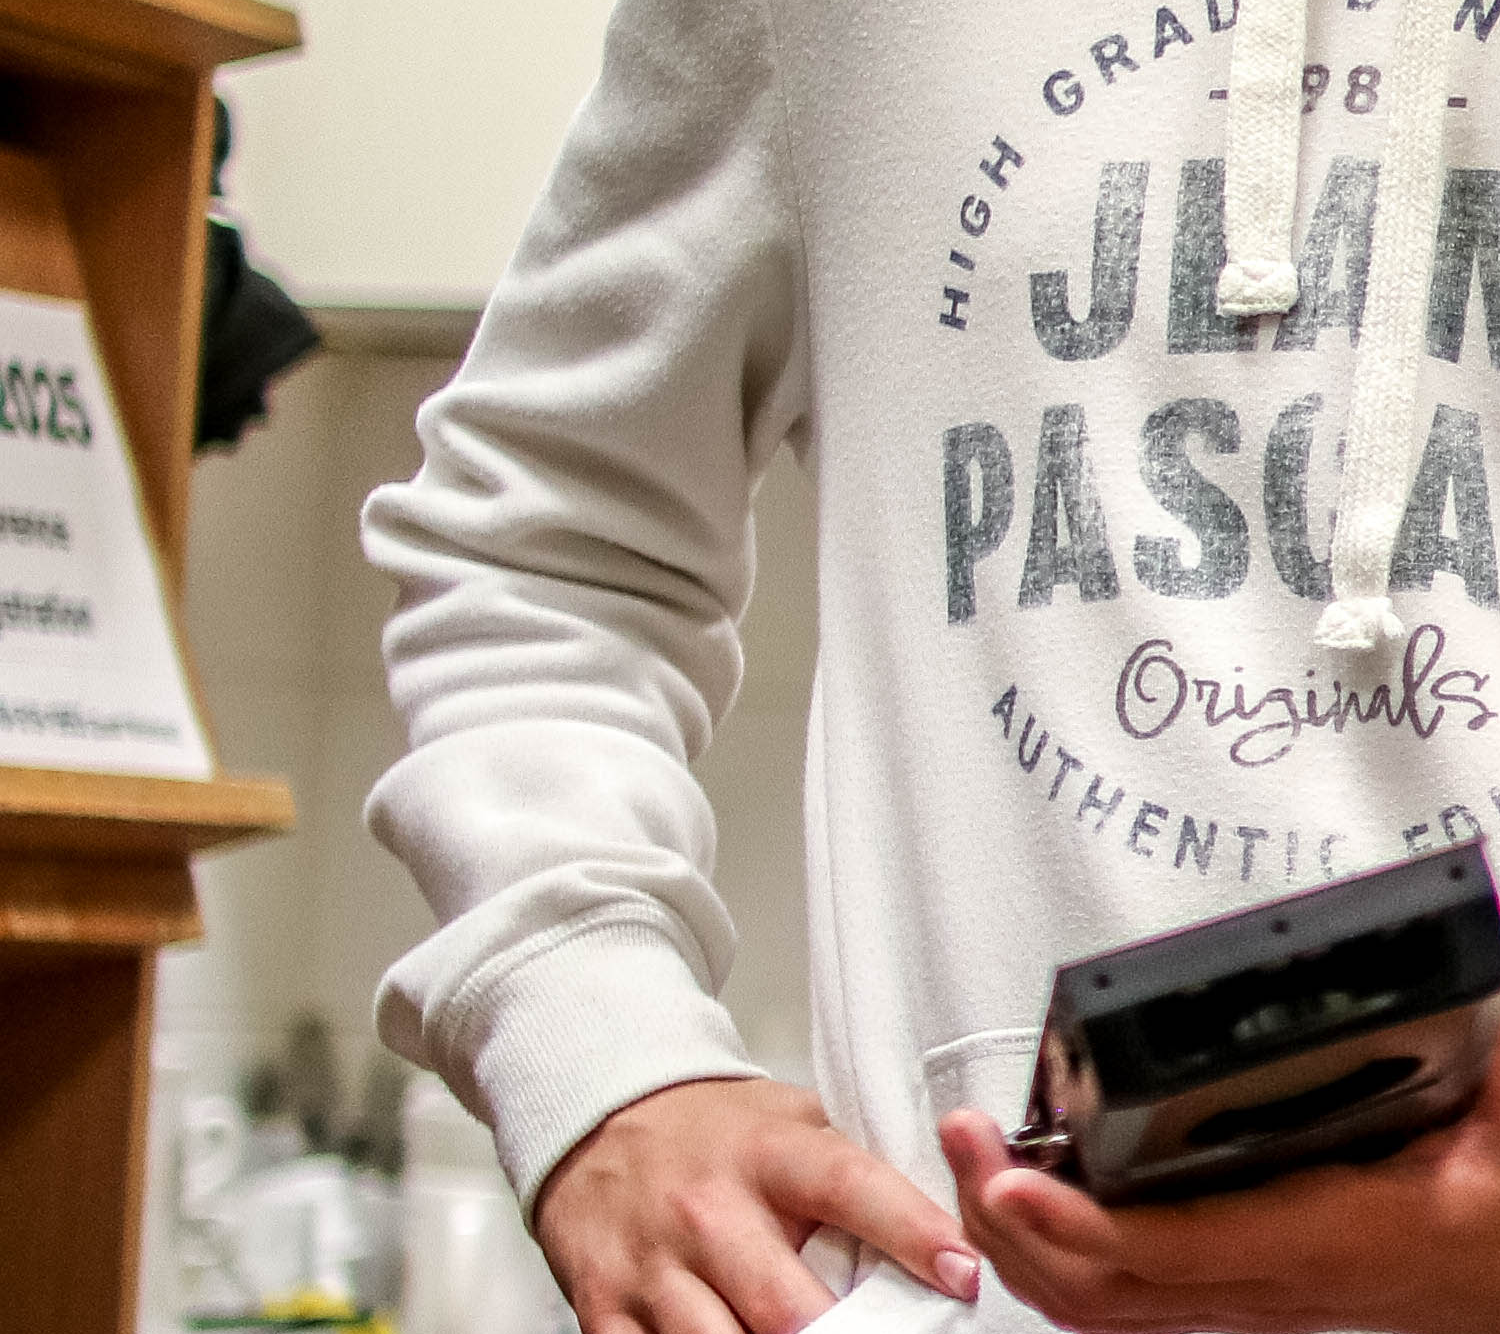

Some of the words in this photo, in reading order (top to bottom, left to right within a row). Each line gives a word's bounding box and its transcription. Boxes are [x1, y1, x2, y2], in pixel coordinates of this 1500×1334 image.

[939, 134, 1026, 331] HIGH
[991, 684, 1350, 882] AUTHENTIC
[1115, 623, 1499, 767] Originals
